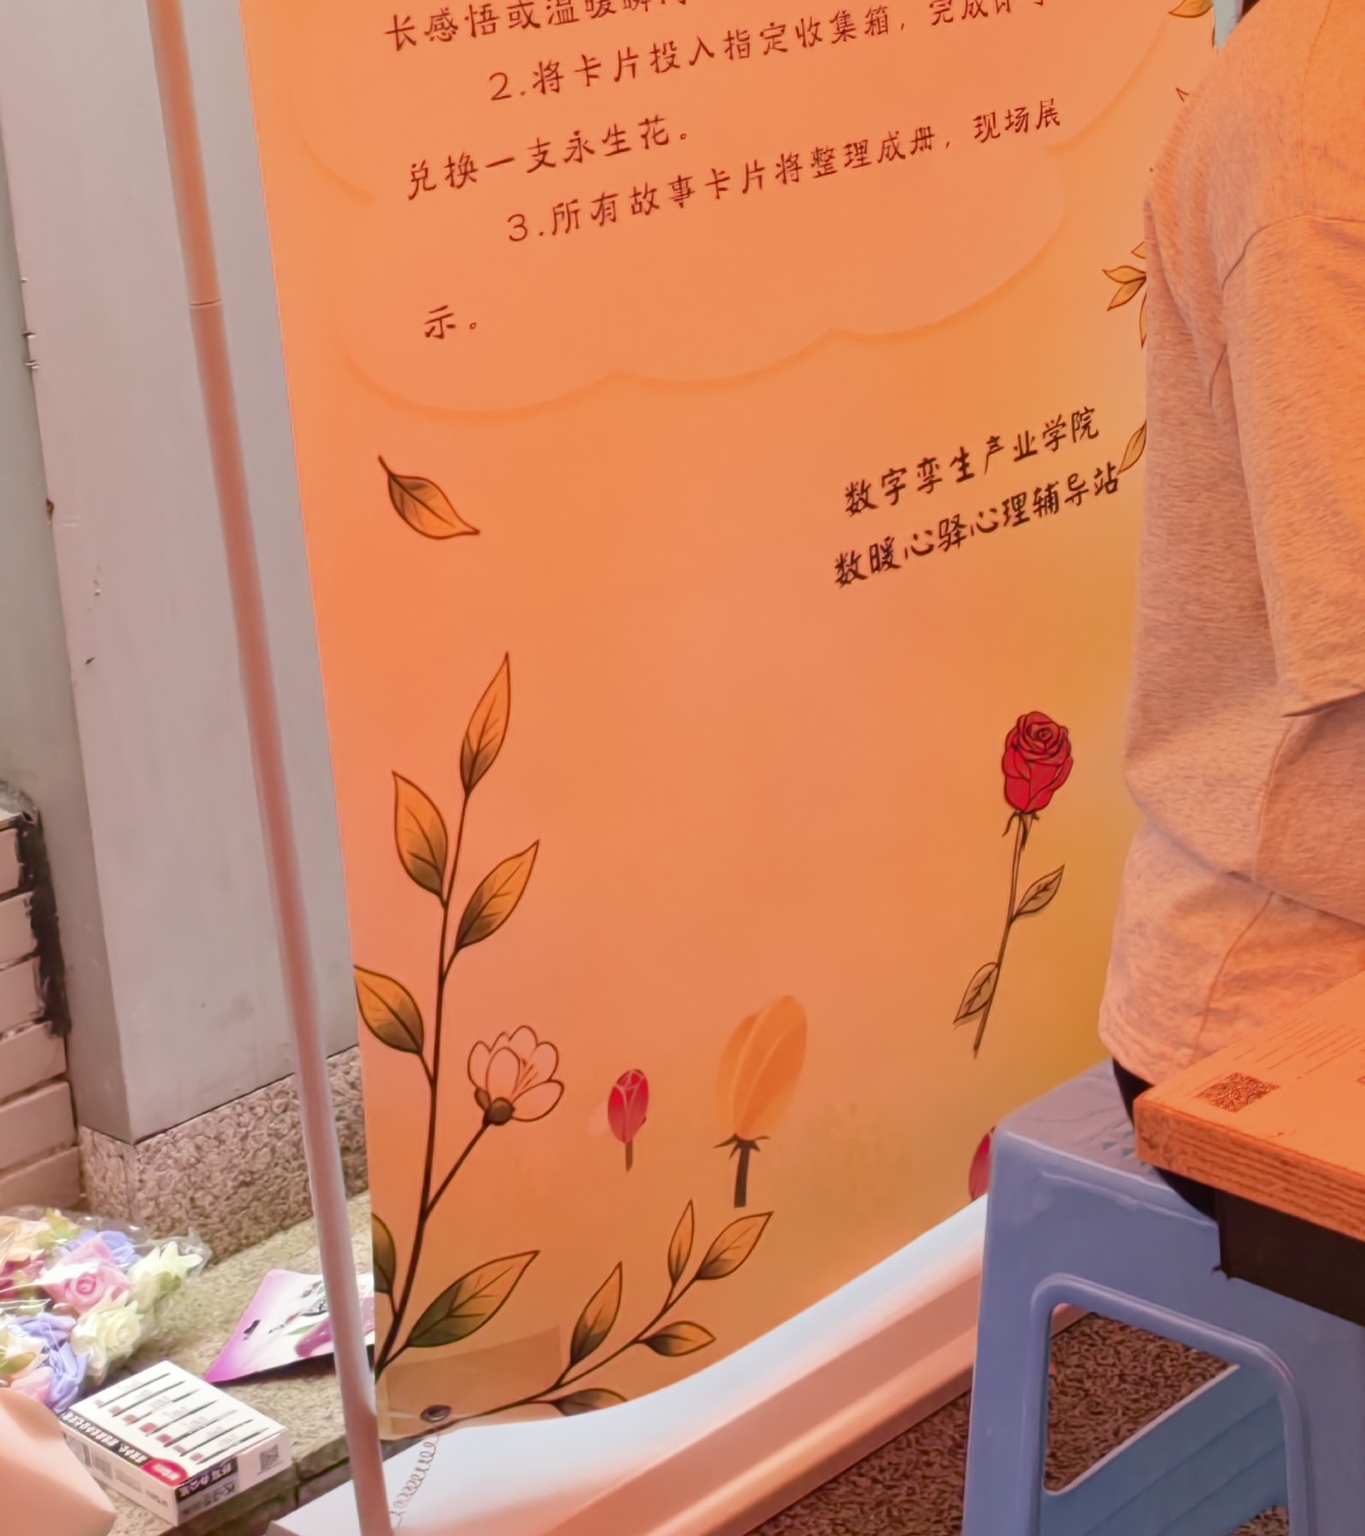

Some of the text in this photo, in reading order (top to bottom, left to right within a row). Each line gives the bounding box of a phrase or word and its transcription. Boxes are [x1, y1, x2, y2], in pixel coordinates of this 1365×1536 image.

[407, 115, 688, 200] 兑换一支永生花。
[423, 304, 479, 343] 示。
[844, 407, 1099, 517] 数字孪生产业学院
[834, 462, 1120, 589] 数暖心驿心理辅导站
